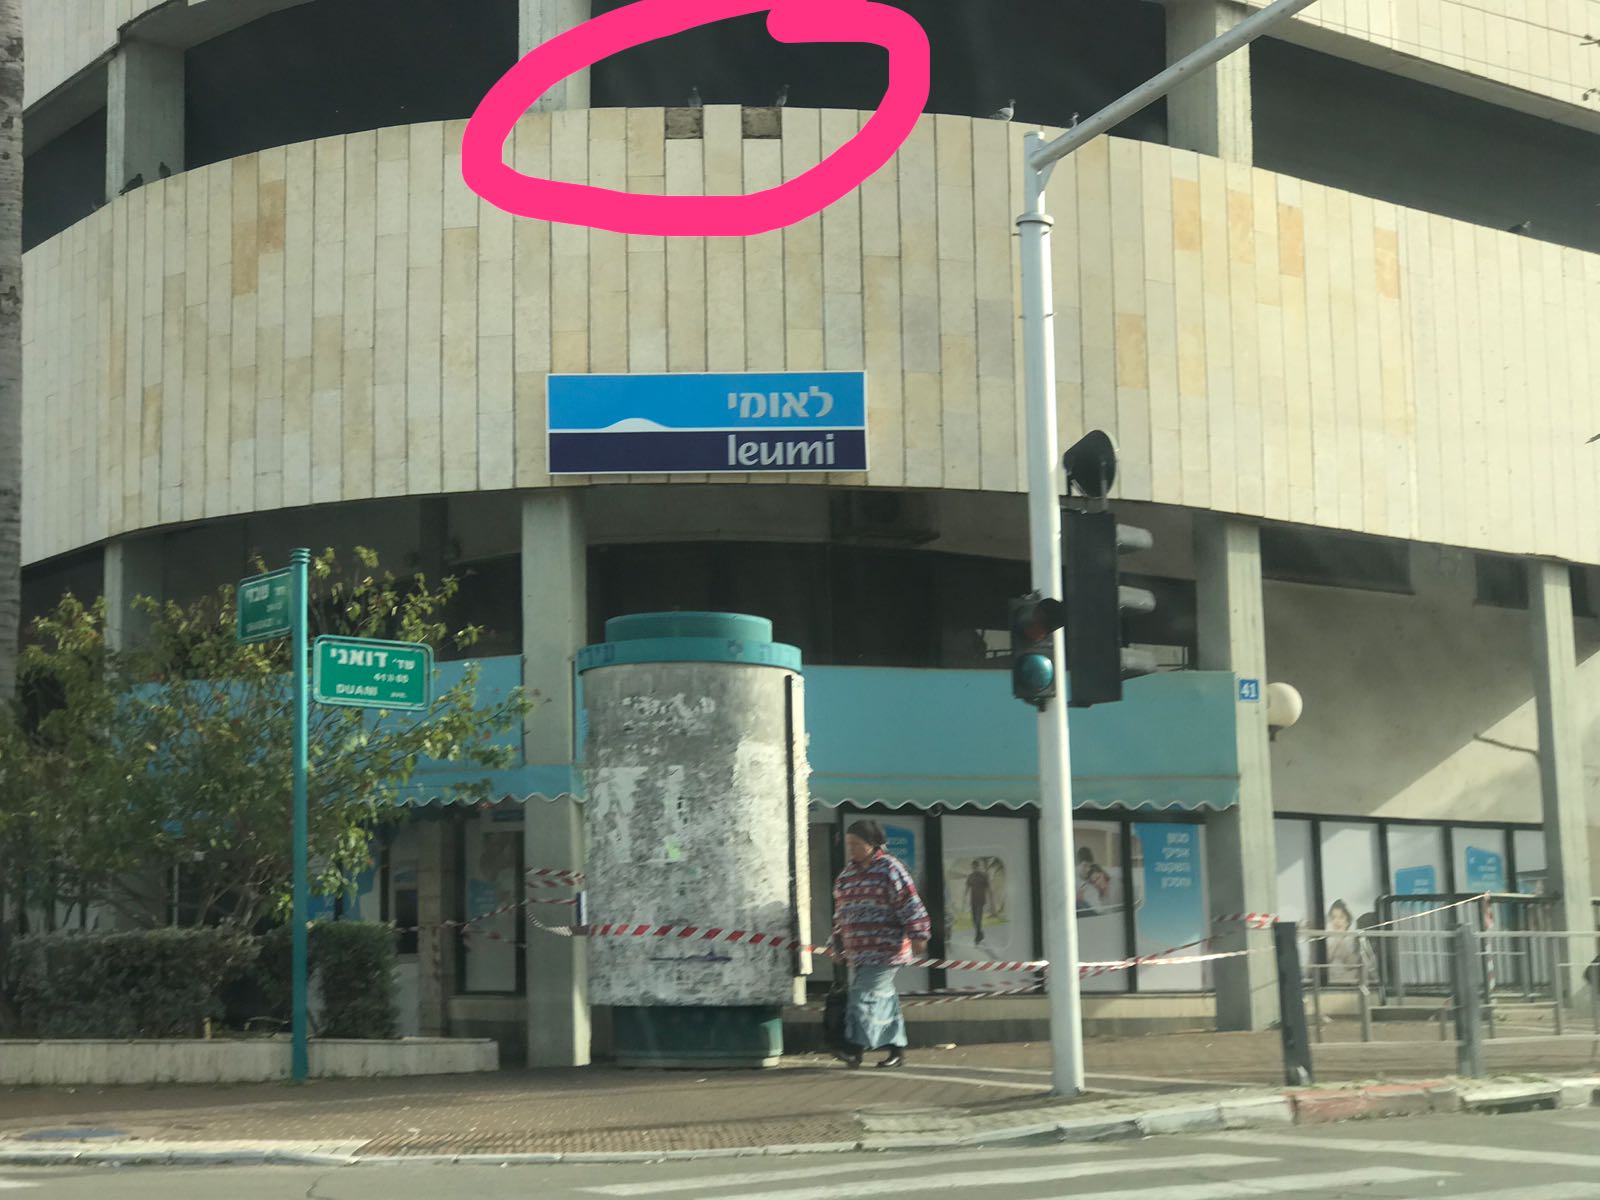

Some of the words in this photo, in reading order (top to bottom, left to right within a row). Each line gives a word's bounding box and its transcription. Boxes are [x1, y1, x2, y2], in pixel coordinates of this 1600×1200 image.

[728, 386, 833, 418] לאומי
[728, 433, 834, 466] leumi
[330, 648, 389, 668] דואני
[1240, 682, 1257, 698] 41
